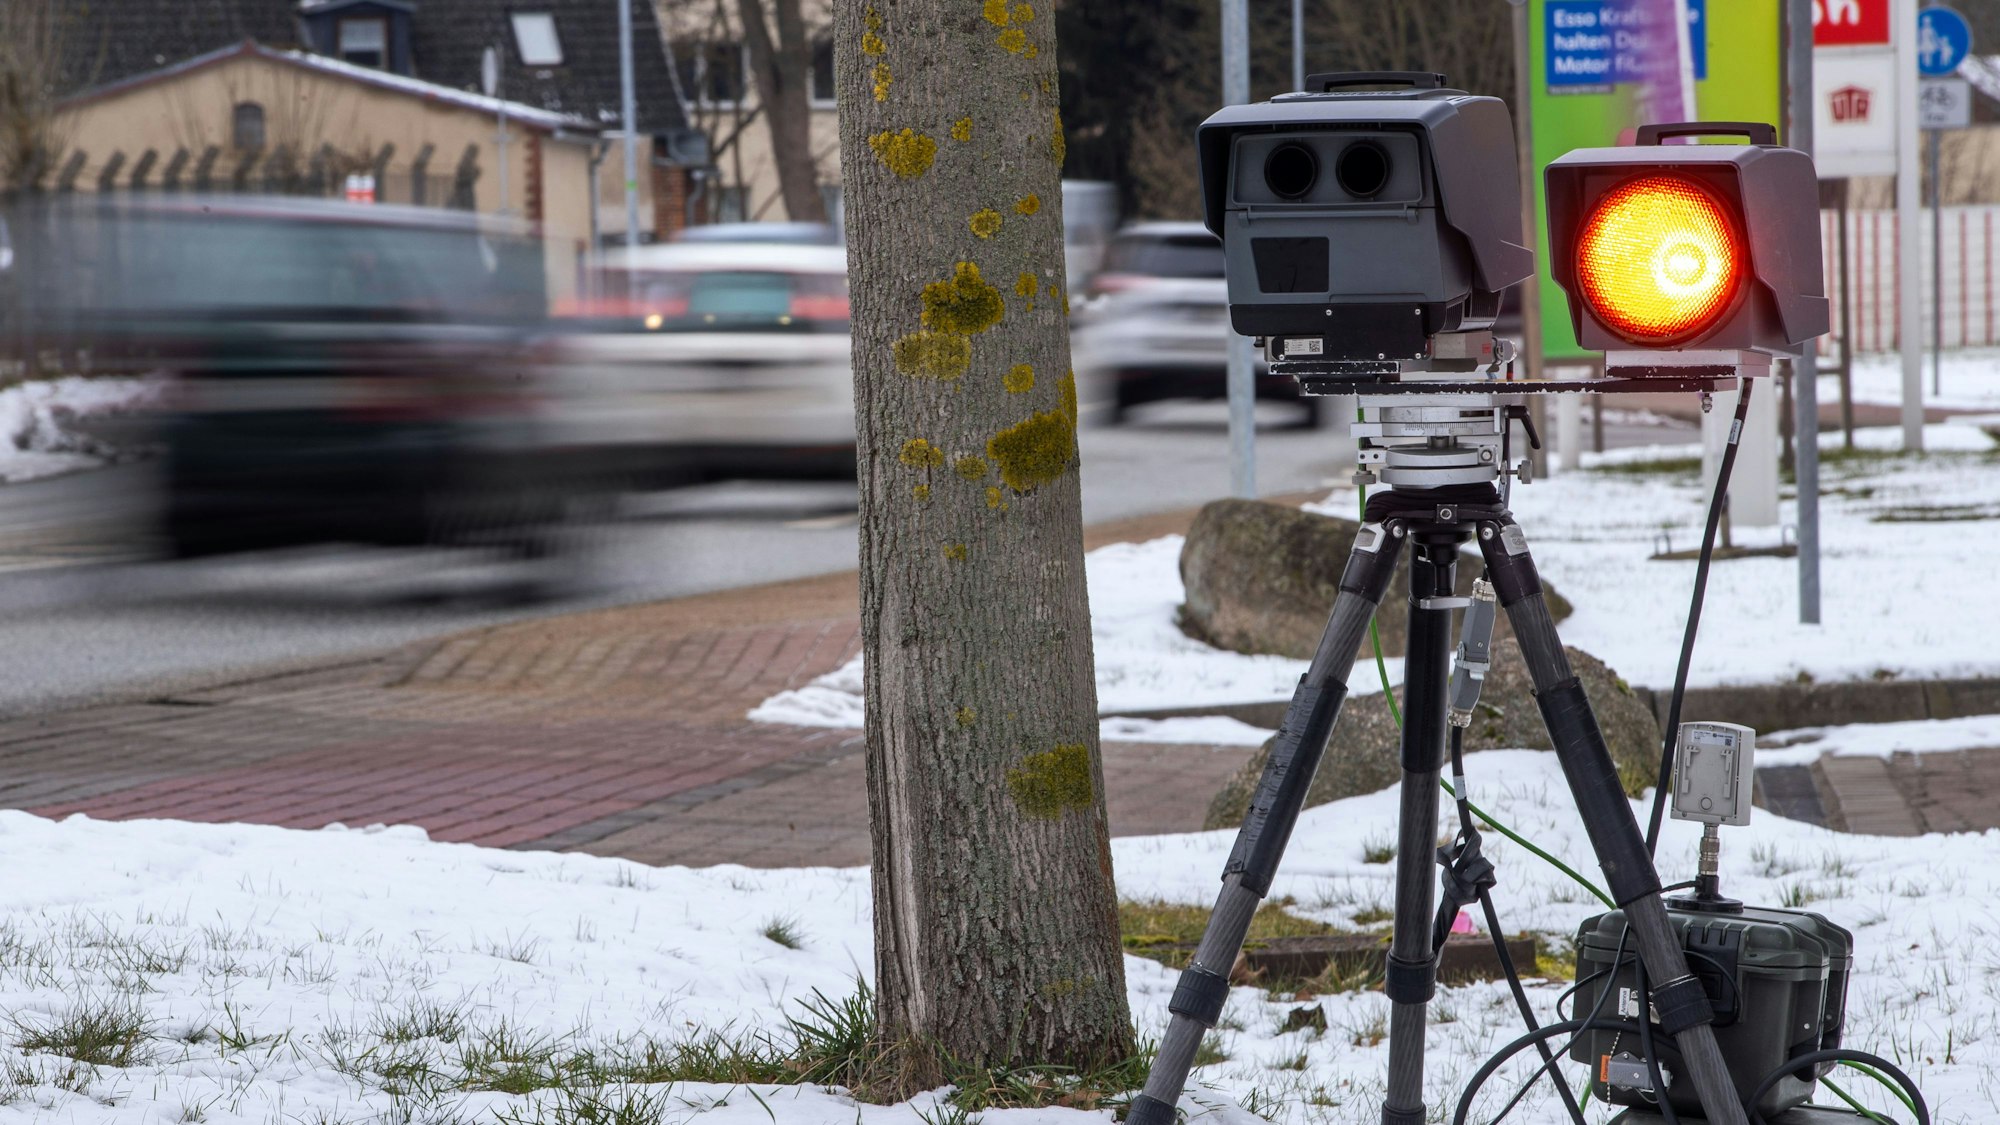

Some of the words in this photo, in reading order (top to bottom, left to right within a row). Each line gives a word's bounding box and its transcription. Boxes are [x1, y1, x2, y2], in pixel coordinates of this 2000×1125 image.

[1554, 9, 1597, 28] Esso
[1554, 32, 1611, 51] halten
[1554, 56, 1610, 74] Motor
[1829, 85, 1871, 123] UTA
